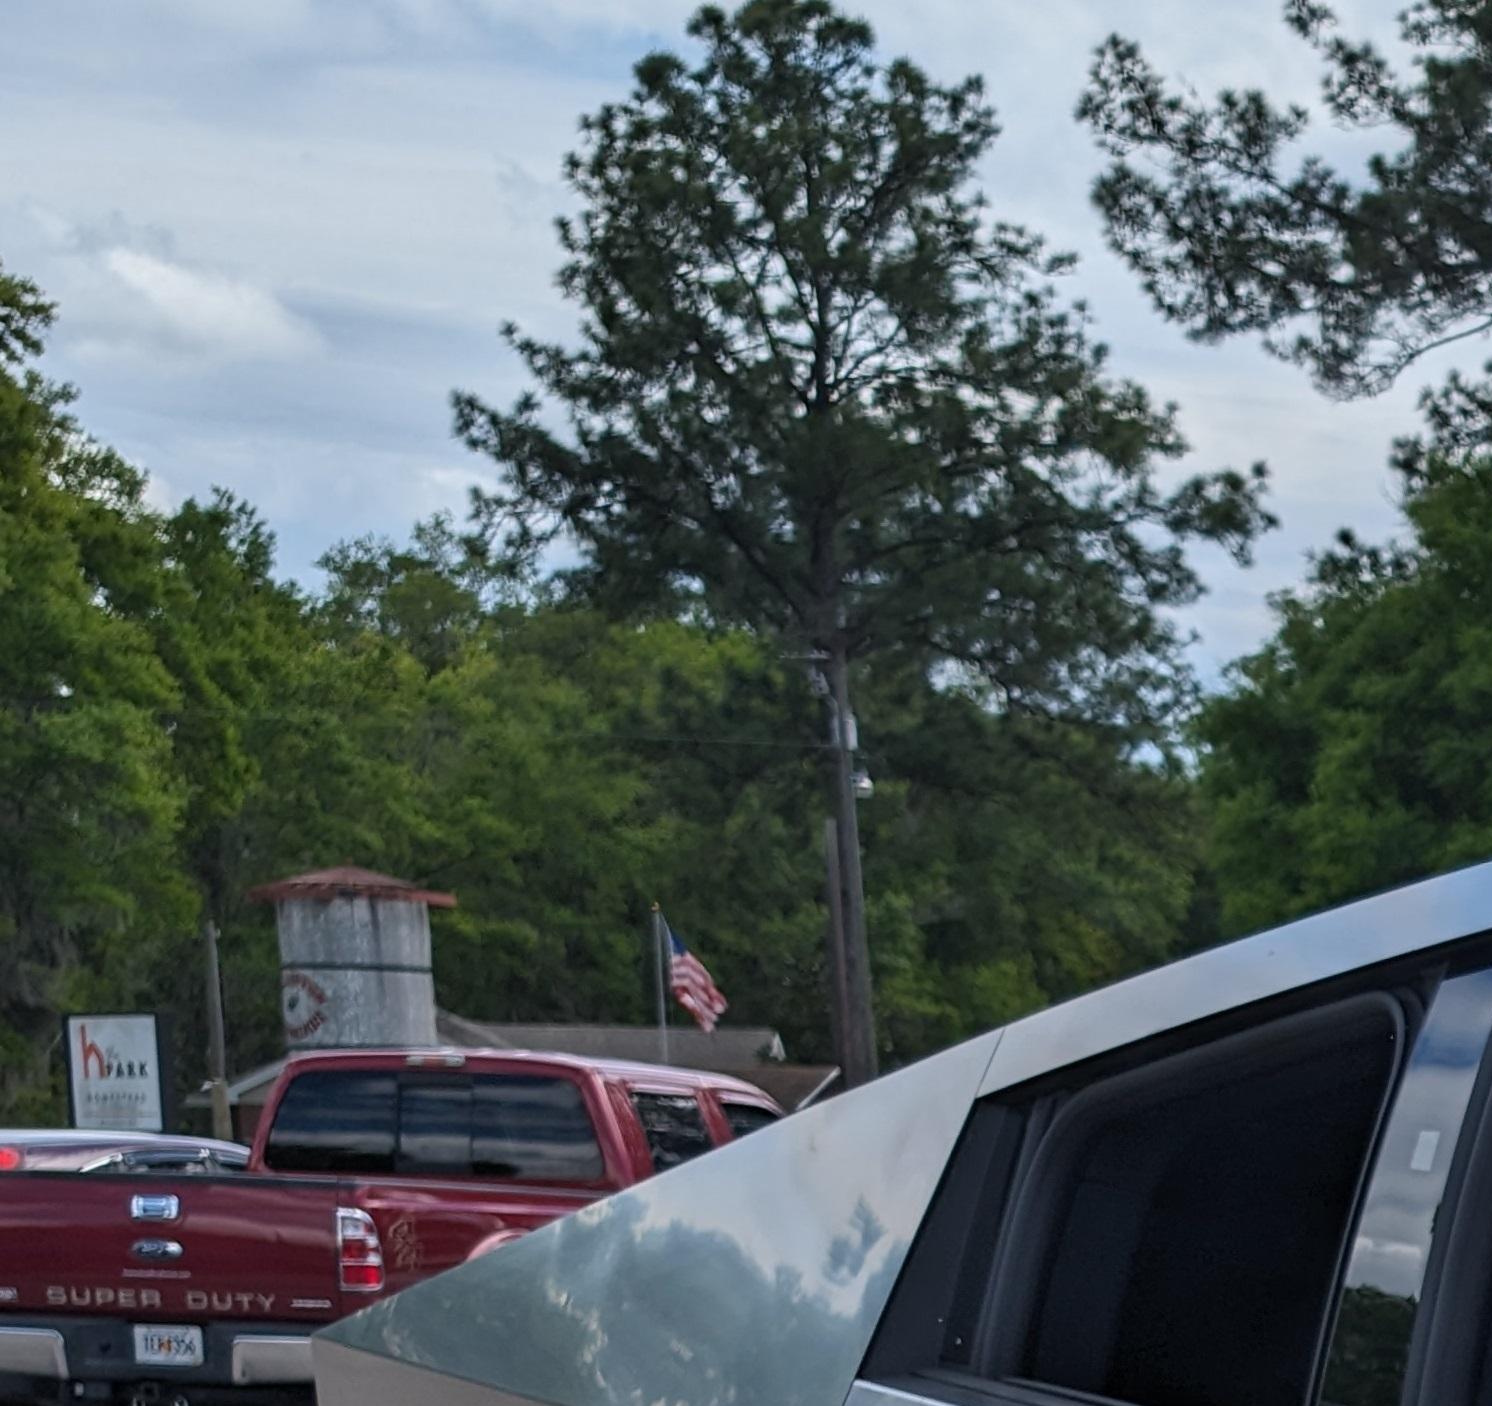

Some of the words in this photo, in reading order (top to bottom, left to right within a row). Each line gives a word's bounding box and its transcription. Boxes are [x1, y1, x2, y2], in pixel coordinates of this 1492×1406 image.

[105, 1061, 148, 1077] PARK
[46, 1285, 162, 1309] SUPER
[186, 1289, 276, 1313] DUTY
